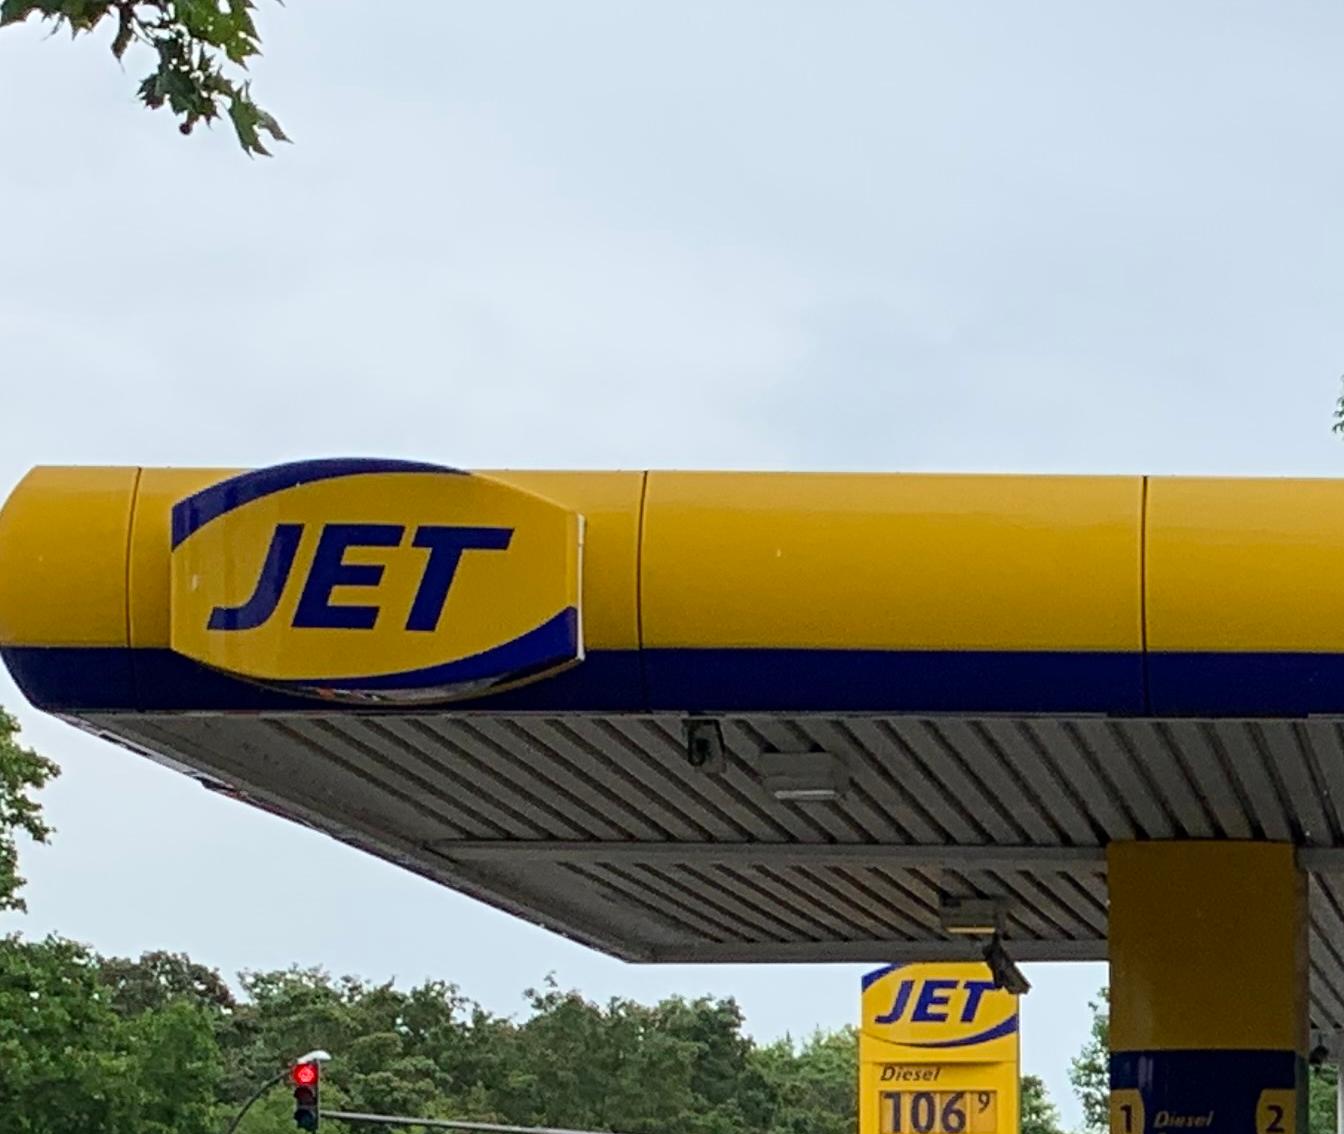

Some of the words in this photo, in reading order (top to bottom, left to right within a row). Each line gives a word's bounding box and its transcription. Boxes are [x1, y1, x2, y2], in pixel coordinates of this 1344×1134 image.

[207, 523, 515, 631] JET
[874, 979, 1002, 1024] JET
[879, 1065, 941, 1082] Diesel
[1120, 1104, 1133, 1134] 1
[1153, 1111, 1214, 1129] Diesel
[1266, 1105, 1286, 1134] 2
